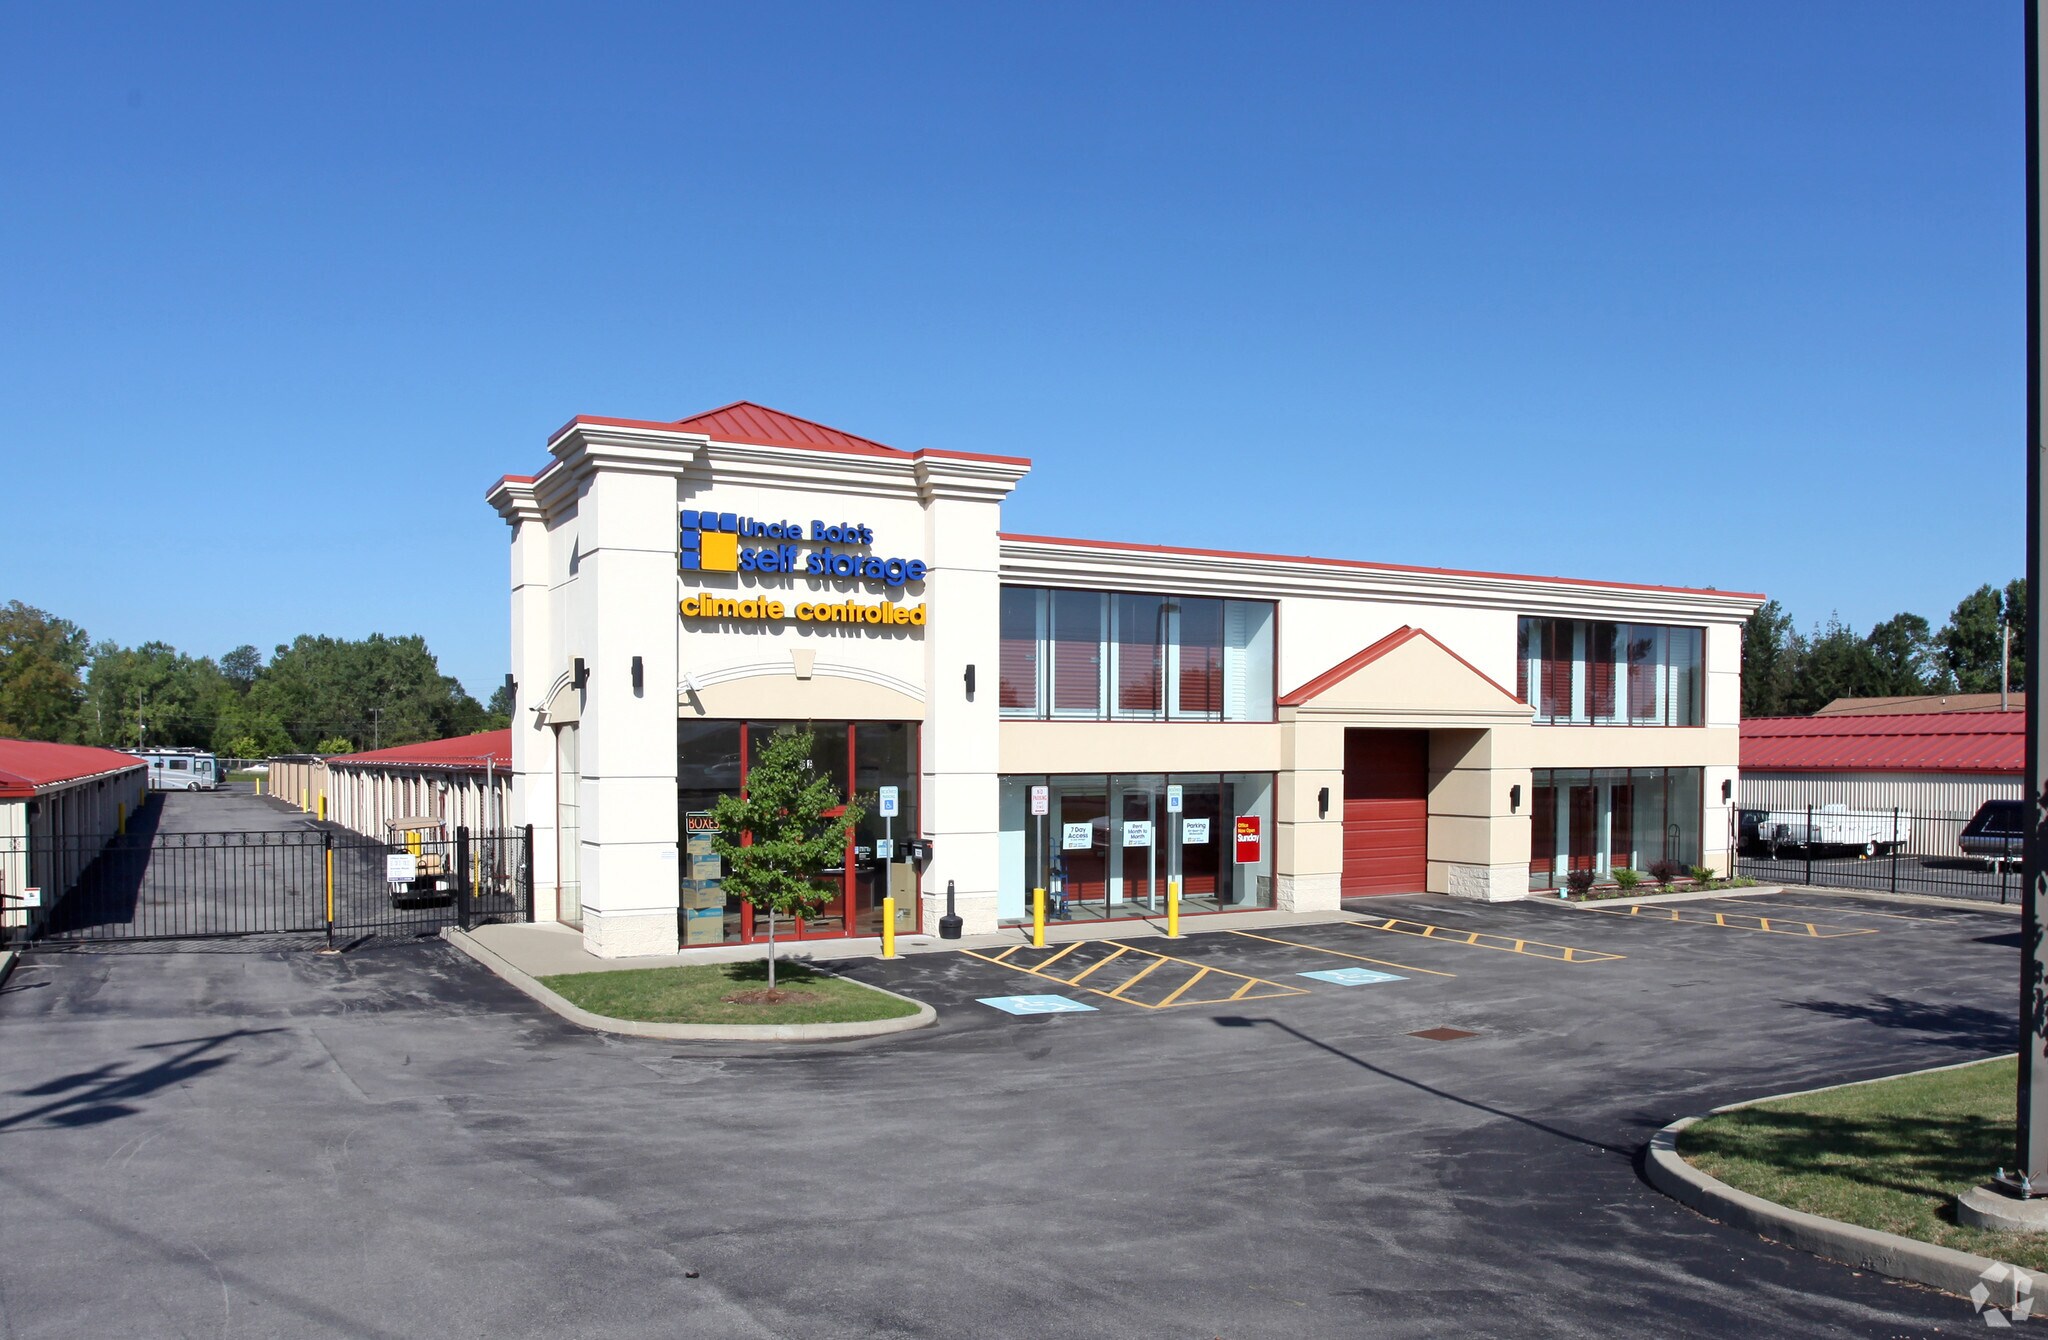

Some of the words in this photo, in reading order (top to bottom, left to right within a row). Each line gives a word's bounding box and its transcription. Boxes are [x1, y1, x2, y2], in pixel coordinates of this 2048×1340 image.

[739, 516, 803, 540] Uncle
[810, 519, 874, 545] Bob's
[740, 544, 798, 573] self
[806, 546, 927, 587] storage
[680, 593, 784, 619] climate
[795, 599, 926, 626] controlled
[688, 817, 721, 829] BOXES
[1187, 822, 1206, 830] Parking
[1237, 833, 1260, 843] Sunday
